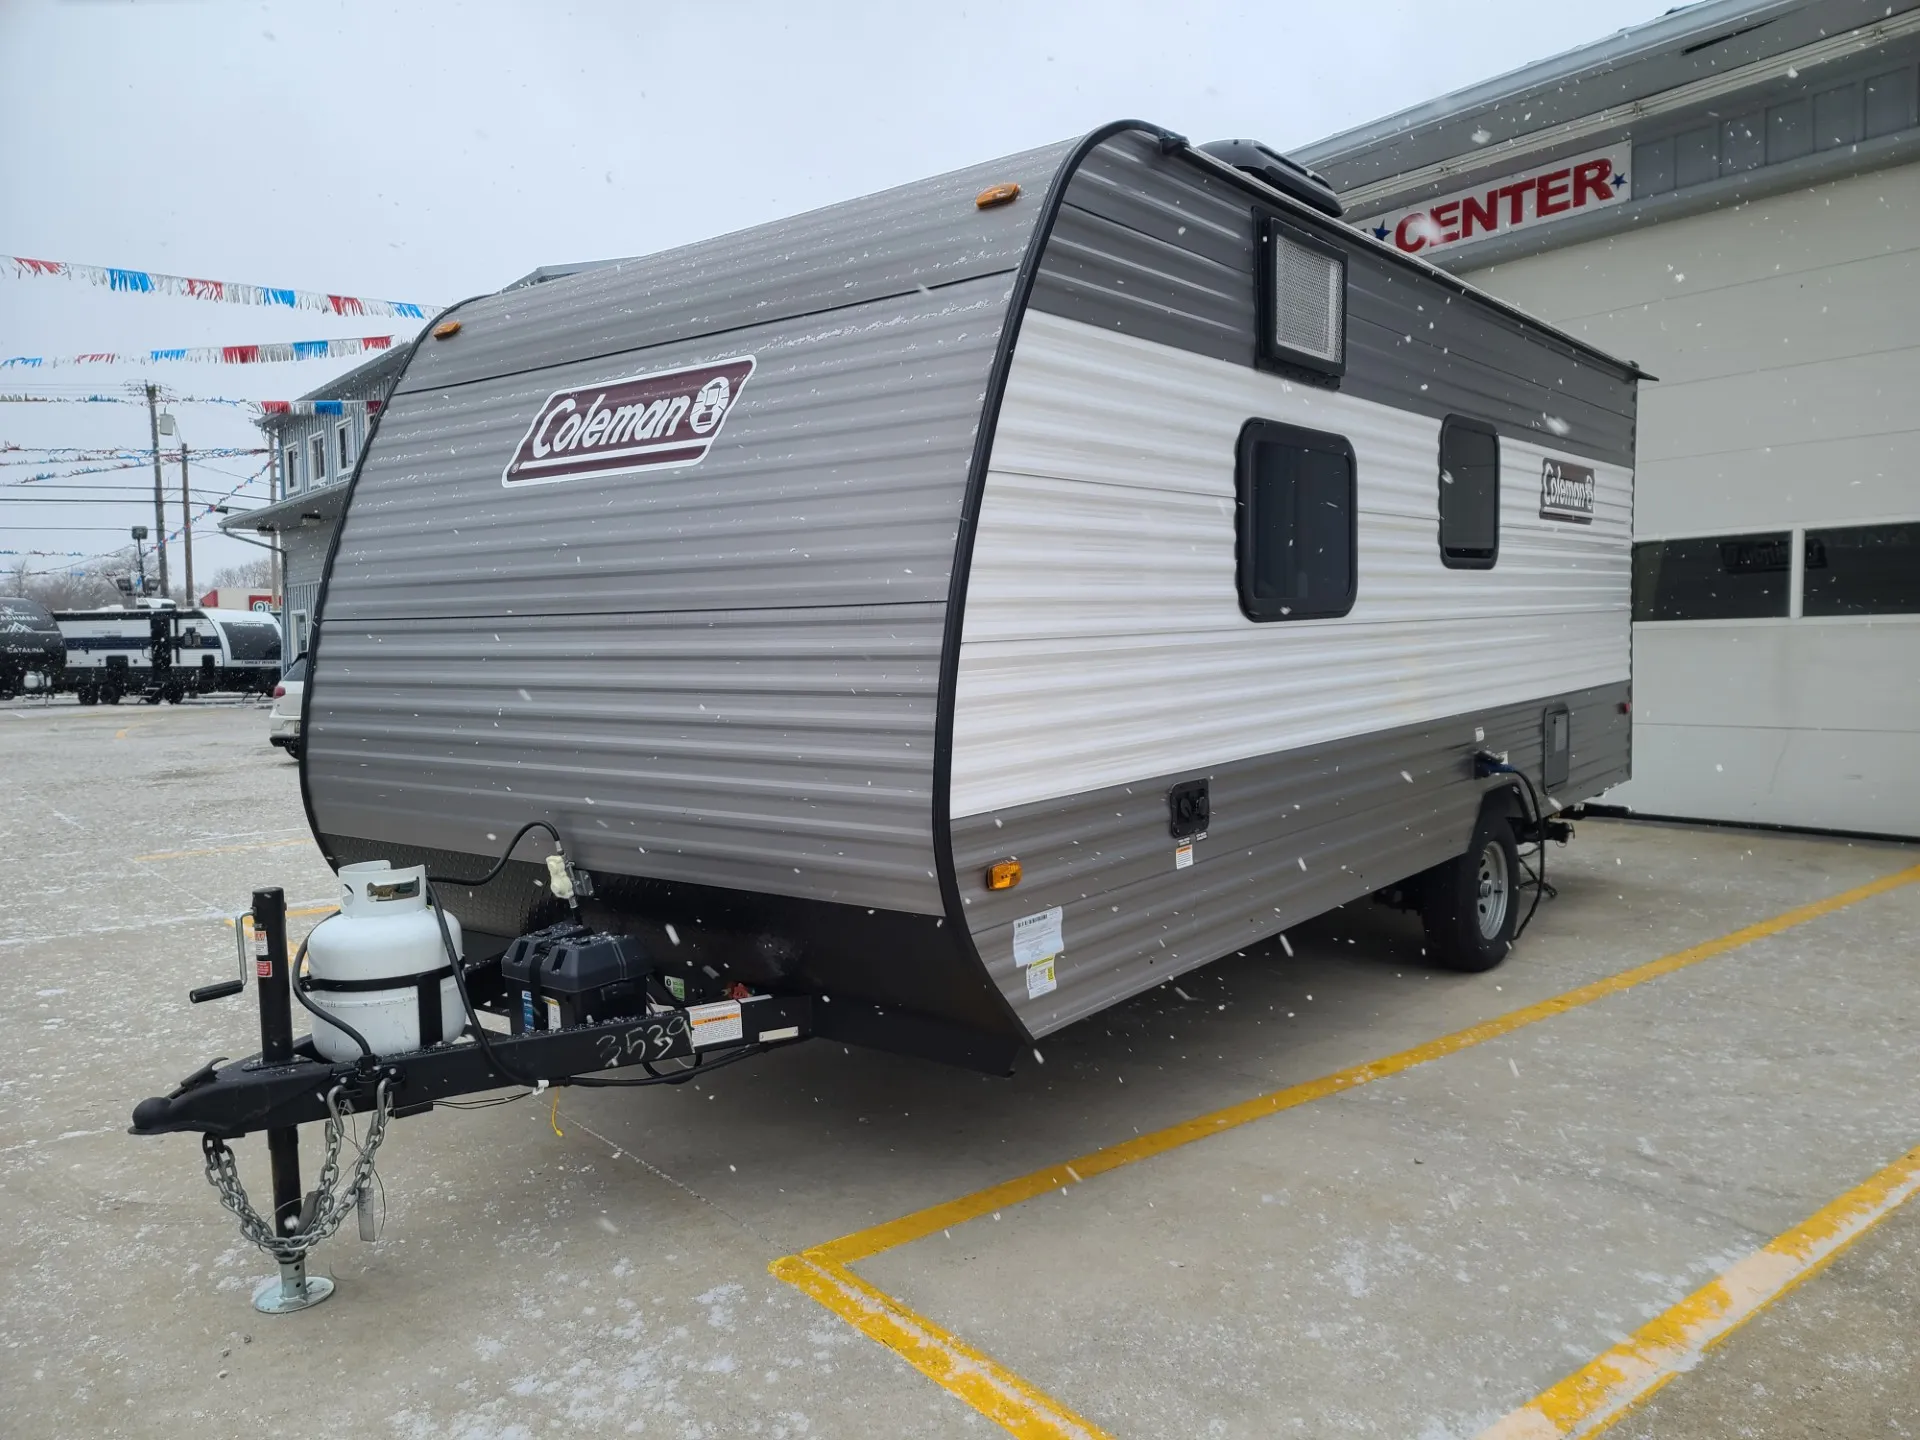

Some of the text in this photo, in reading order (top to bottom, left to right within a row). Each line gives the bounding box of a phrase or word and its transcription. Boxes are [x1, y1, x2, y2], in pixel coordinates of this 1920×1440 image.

[1395, 157, 1615, 253] CENTER
[533, 394, 690, 458] Coleman
[1543, 463, 1585, 507] Coleman
